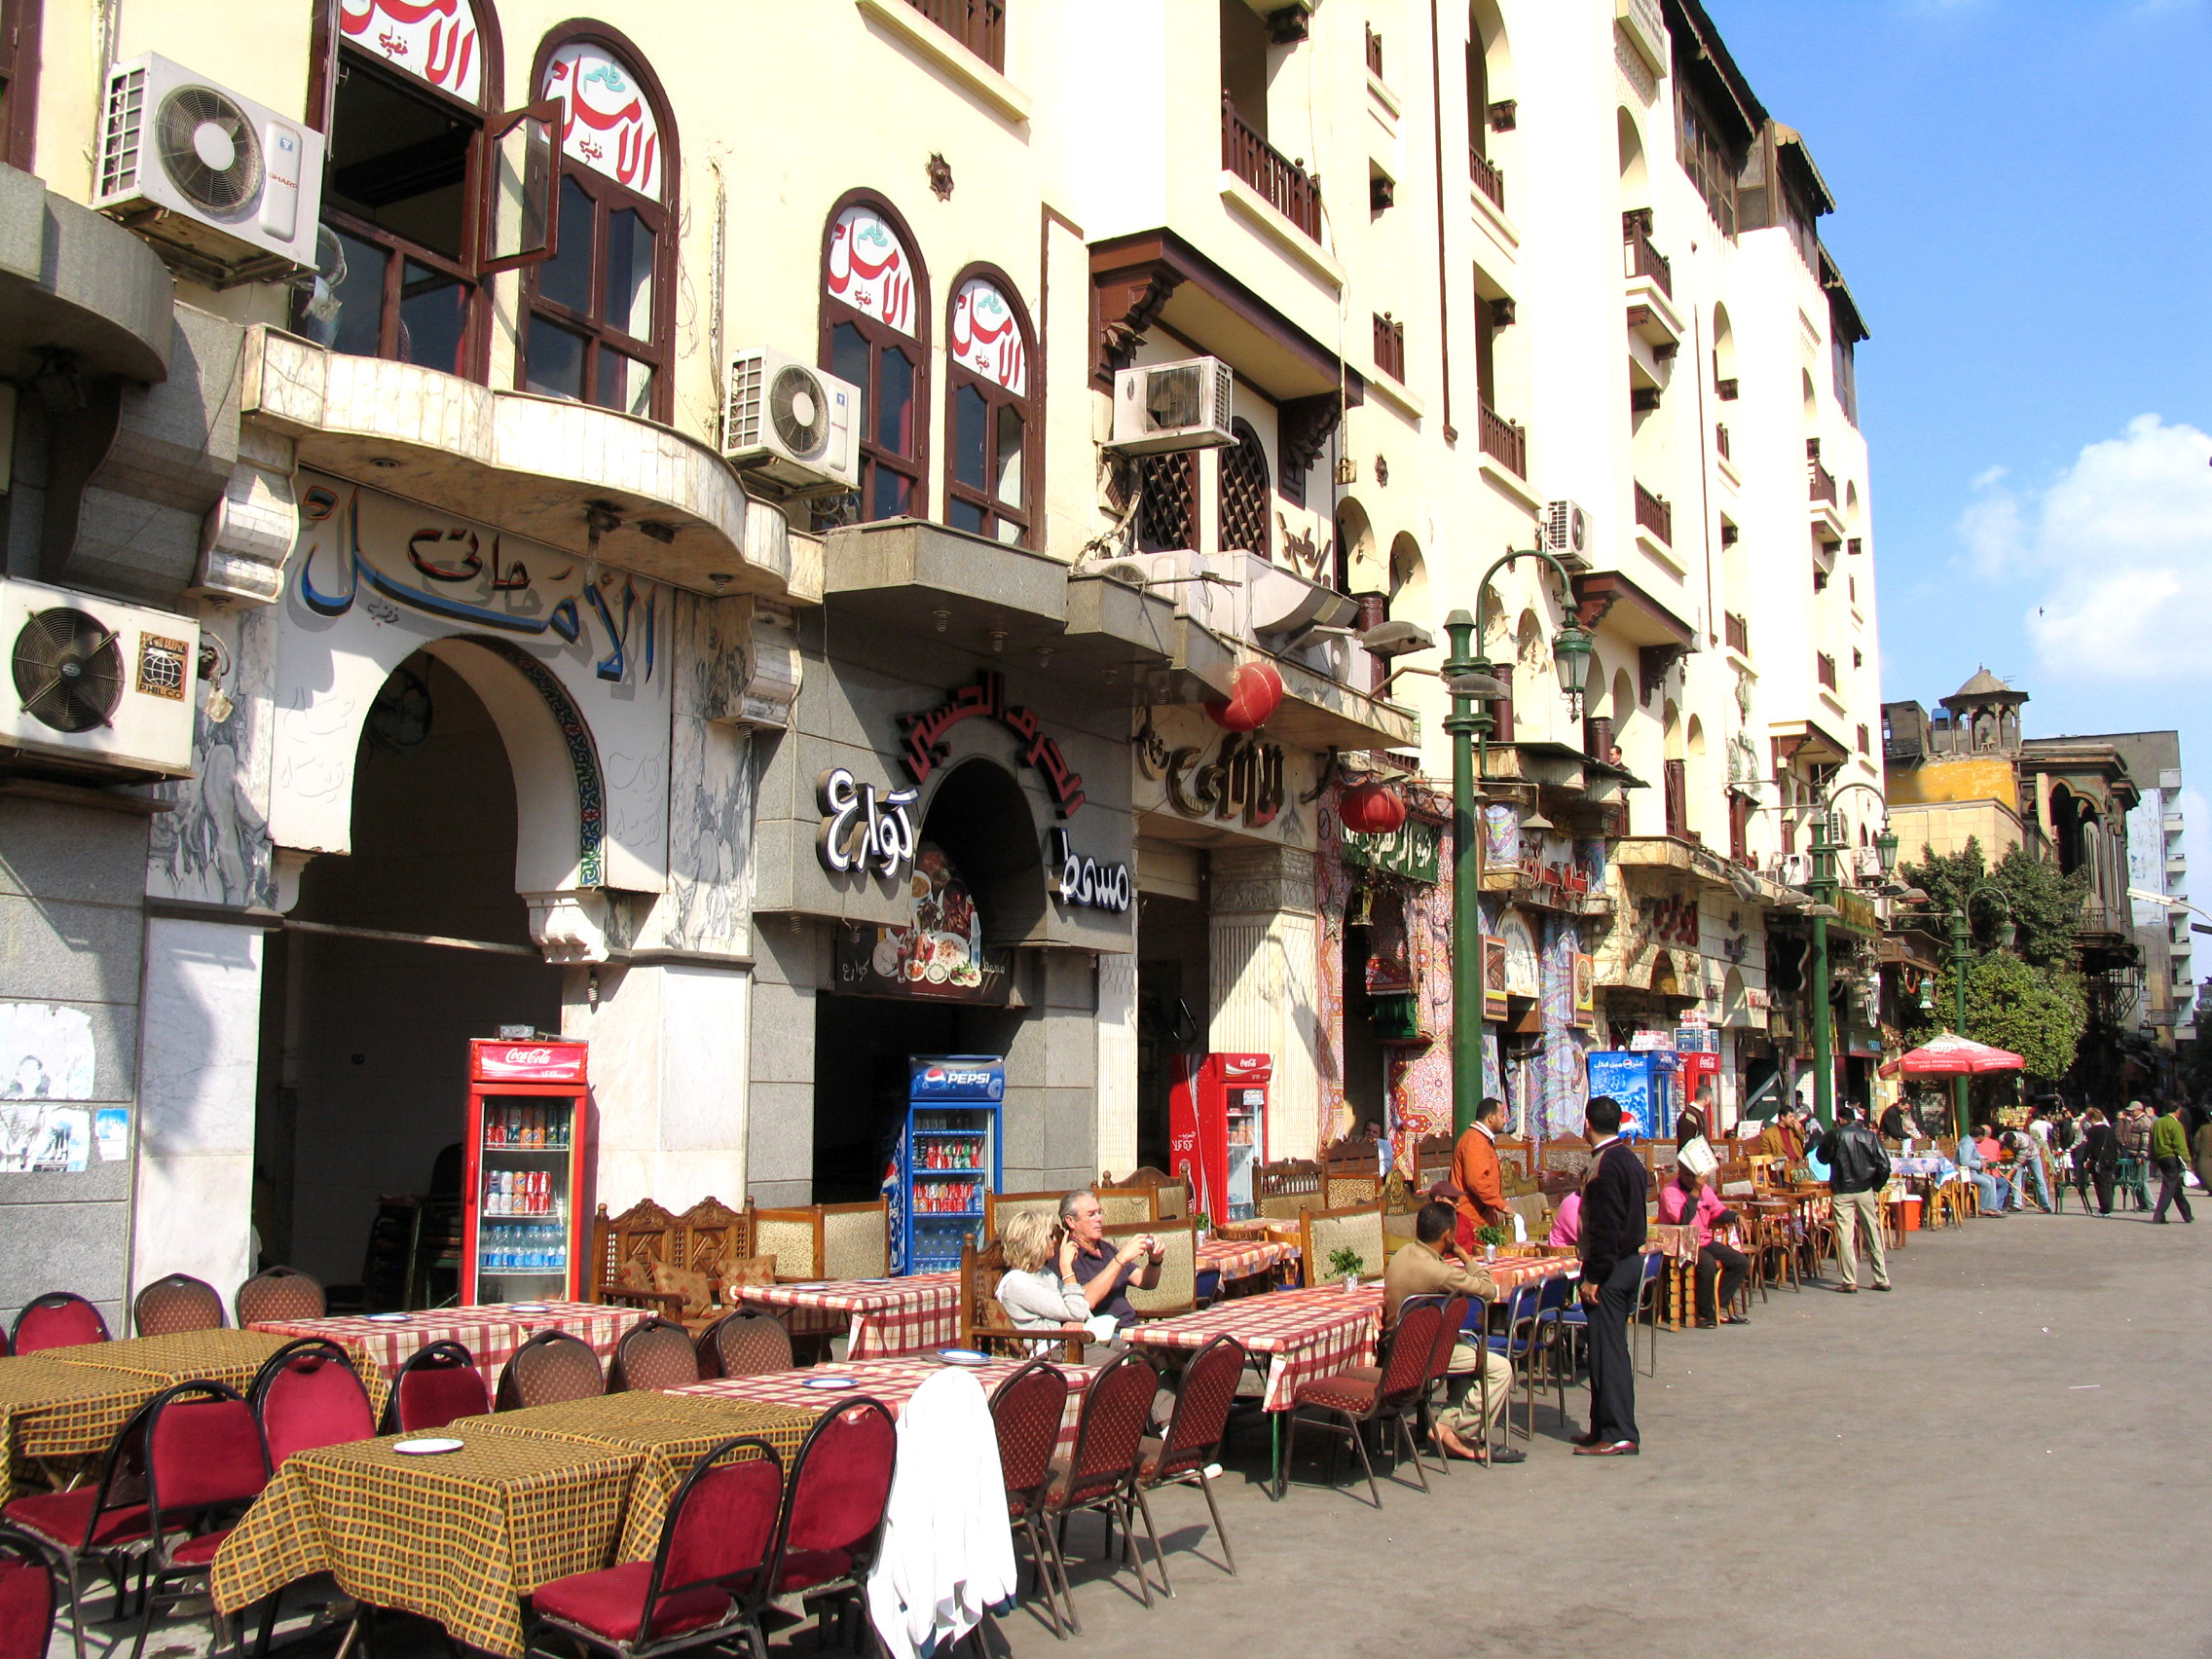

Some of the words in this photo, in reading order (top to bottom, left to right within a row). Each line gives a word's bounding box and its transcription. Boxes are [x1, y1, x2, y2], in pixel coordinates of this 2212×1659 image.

[267, 171, 298, 189] SHARP
[138, 682, 183, 700] PHILCO
[827, 767, 920, 879] كوارع
[946, 1073, 990, 1085] PEPSI
